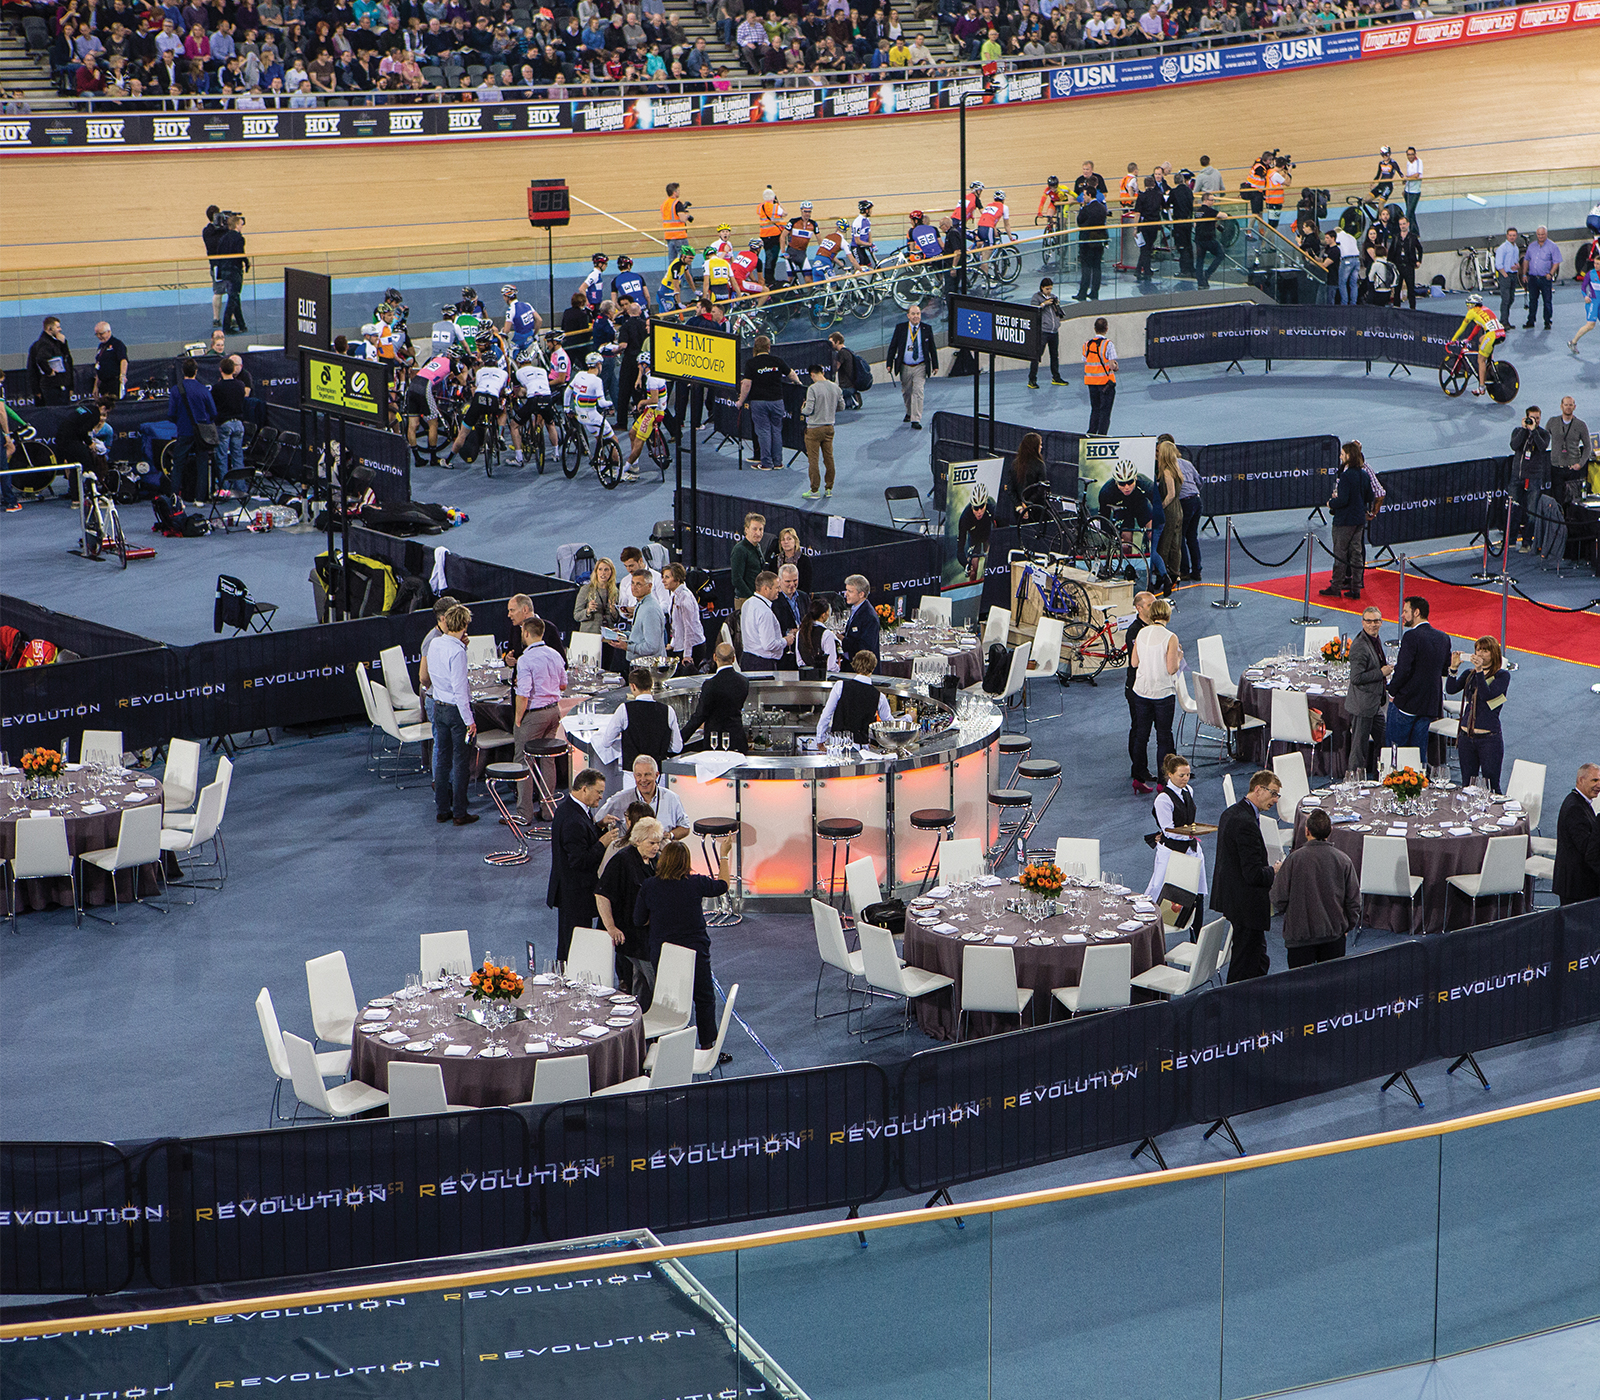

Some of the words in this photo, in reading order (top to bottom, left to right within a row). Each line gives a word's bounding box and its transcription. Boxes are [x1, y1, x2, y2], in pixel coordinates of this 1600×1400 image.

[1282, 38, 1321, 61] USN
[1180, 51, 1220, 74] USN
[1074, 65, 1115, 87] USN
[305, 118, 340, 132] HOY
[390, 116, 423, 129] HOY
[449, 113, 482, 127] HOY
[528, 110, 560, 124] HOY
[87, 124, 125, 138] HOY
[154, 122, 191, 136] HOY
[243, 120, 278, 134] HOY
[298, 298, 317, 319] ELITE
[298, 318, 317, 335] WOMEN
[995, 314, 1010, 326] REST
[1011, 316, 1019, 328] OF
[1020, 318, 1031, 330] THE
[995, 325, 1026, 344] WORLD
[1154, 332, 1205, 343] REVOLUTION
[1212, 328, 1269, 338] REVOLUTION
[1278, 328, 1346, 337] REVOLUTION
[1357, 330, 1415, 341] REVOLUTION
[685, 334, 714, 354] HMT
[665, 350, 726, 373] SPORTSCOVER
[316, 385, 337, 395] Champion
[318, 391, 336, 401] System
[1086, 444, 1120, 457] HOY
[359, 457, 403, 476] REVOLUTION
[953, 469, 978, 483] HOY
[1237, 469, 1309, 481] REVOLUTION
[1379, 499, 1437, 514] EVOLUTION
[243, 665, 345, 689] REVOLUTION
[119, 683, 225, 708] REVOLUTION
[1437, 966, 1548, 1003] REVOLUTION
[1303, 998, 1419, 1038] REVOLUTION
[1160, 1031, 1284, 1073] REVOLUTION
[1004, 1068, 1138, 1109] REVOLUTION
[830, 1105, 980, 1145] REVOLUTION
[630, 1137, 801, 1172] REVOLUTION
[419, 1164, 600, 1198] REVOLUTION
[196, 1189, 387, 1222] REVOLUTION
[443, 1271, 653, 1302] REVOLUTION
[188, 1298, 406, 1326] REVOLUTION
[479, 1328, 696, 1362] REVOLUTION
[215, 1359, 440, 1389] REVOLUTION
